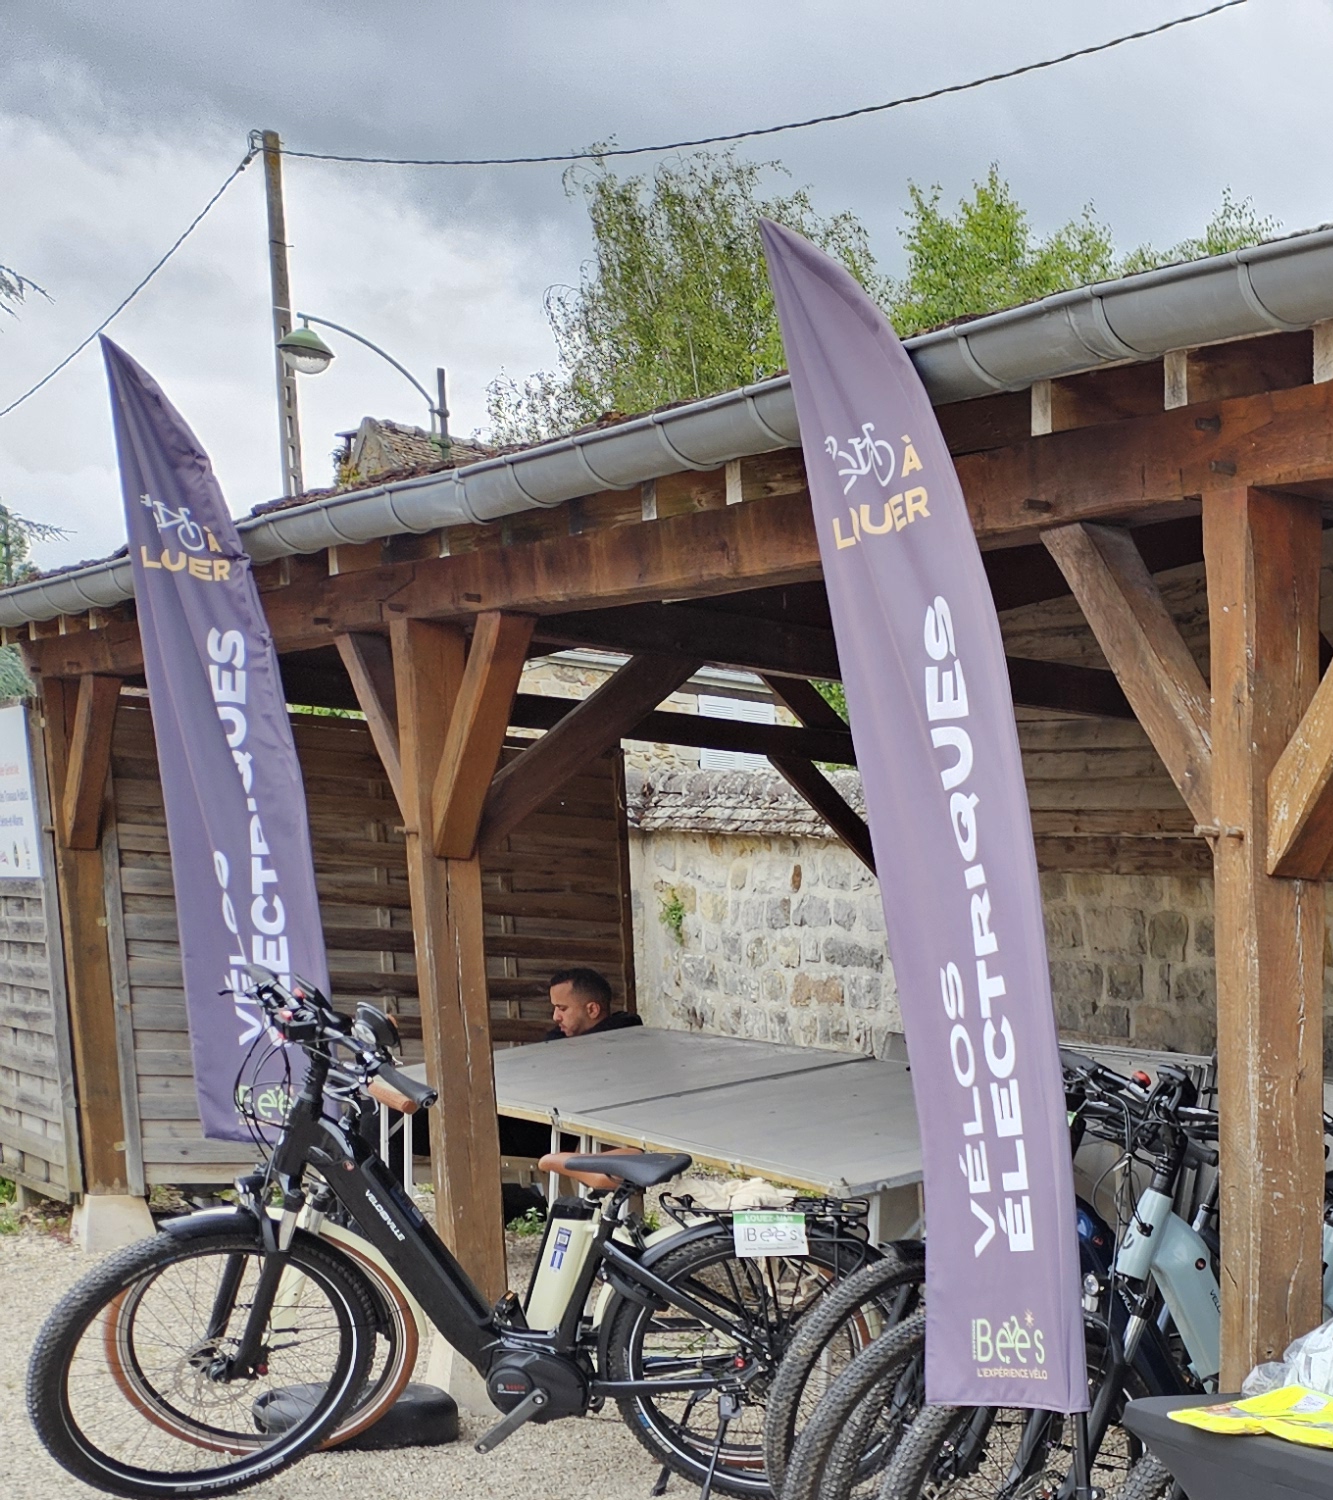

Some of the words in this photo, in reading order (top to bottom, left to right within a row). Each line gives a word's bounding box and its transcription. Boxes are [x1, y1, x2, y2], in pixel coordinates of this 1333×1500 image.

[901, 433, 924, 478] À
[203, 525, 223, 553] À
[832, 485, 931, 550] LUER
[140, 545, 231, 582] LUER
[923, 595, 1035, 1252] ÉLECTRIQUES
[940, 960, 991, 1258] VÉLOS
[1029, 1367, 1048, 1381] VÉLO
